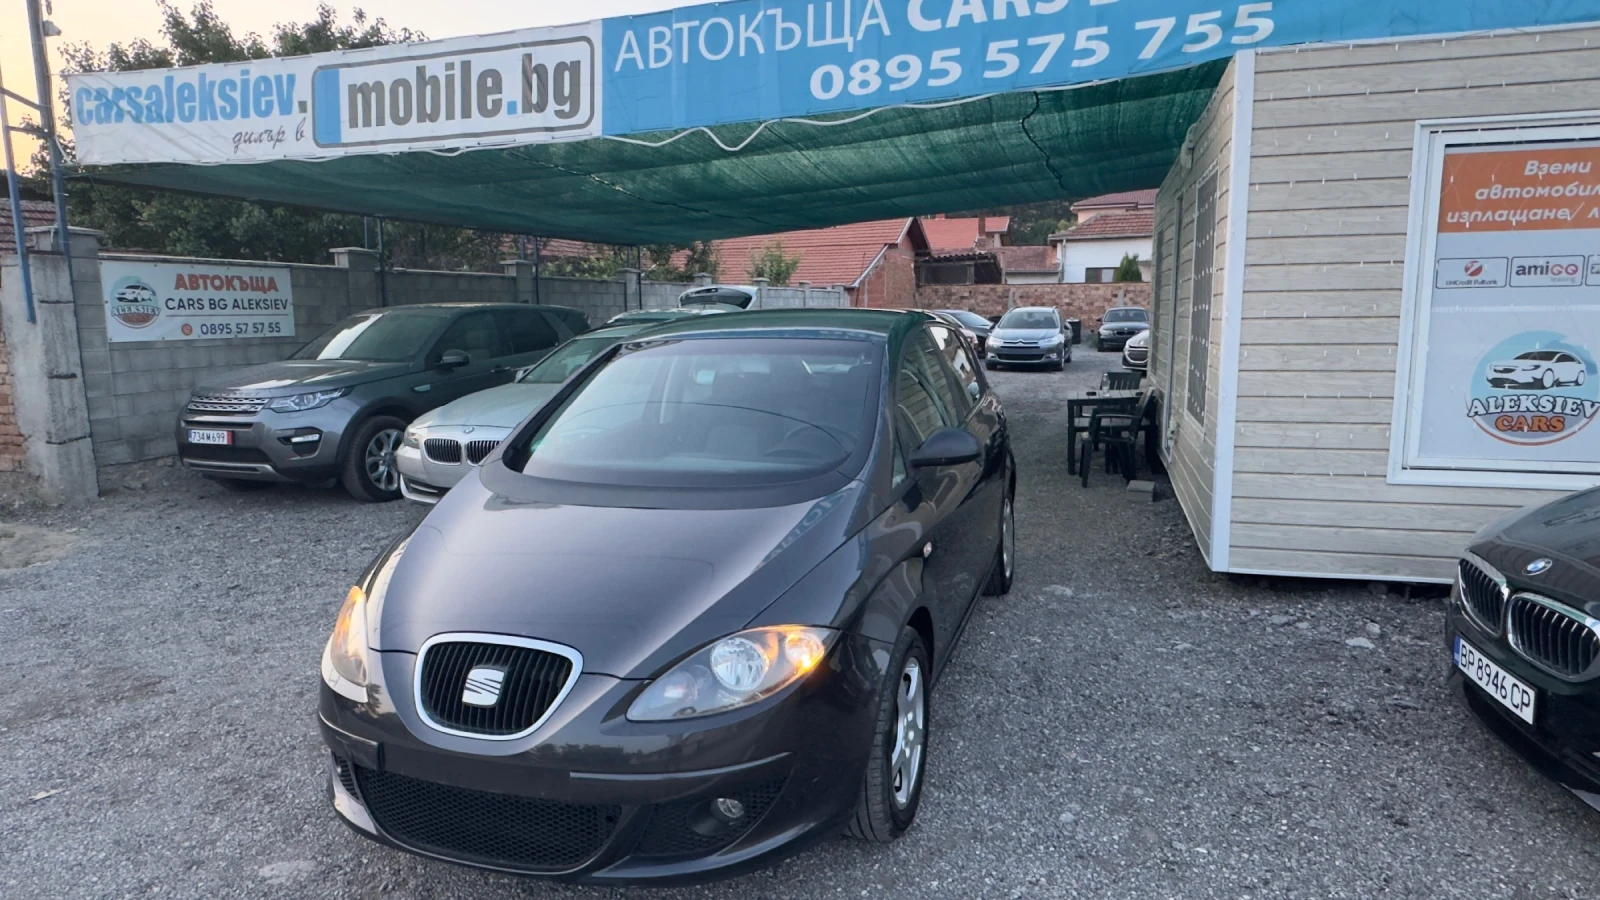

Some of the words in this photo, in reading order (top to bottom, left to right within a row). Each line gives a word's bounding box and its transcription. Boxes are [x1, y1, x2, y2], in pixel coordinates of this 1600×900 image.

[614, 0, 891, 72] АВТОКЪЩА
[809, 47, 962, 100] 0895
[984, 26, 1111, 79] 575
[1134, 1, 1275, 60] 755
[347, 53, 582, 129] mobile.bg
[1524, 160, 1592, 176] Вземи
[174, 273, 279, 294] АВТОКЪЩА
[111, 304, 162, 317] ALEKSIEV
[165, 298, 205, 311] CARS
[208, 298, 228, 311] BG
[232, 298, 288, 311] ALEKSIEV
[200, 323, 233, 336] 0895
[236, 323, 249, 335] 57
[252, 323, 265, 334] 57
[268, 322, 281, 334] 55
[1467, 394, 1600, 419] ALEKSIEV
[1495, 415, 1566, 433] CARS
[1460, 643, 1475, 671] BP
[1476, 658, 1508, 700] 8946
[1510, 682, 1531, 713] CP
